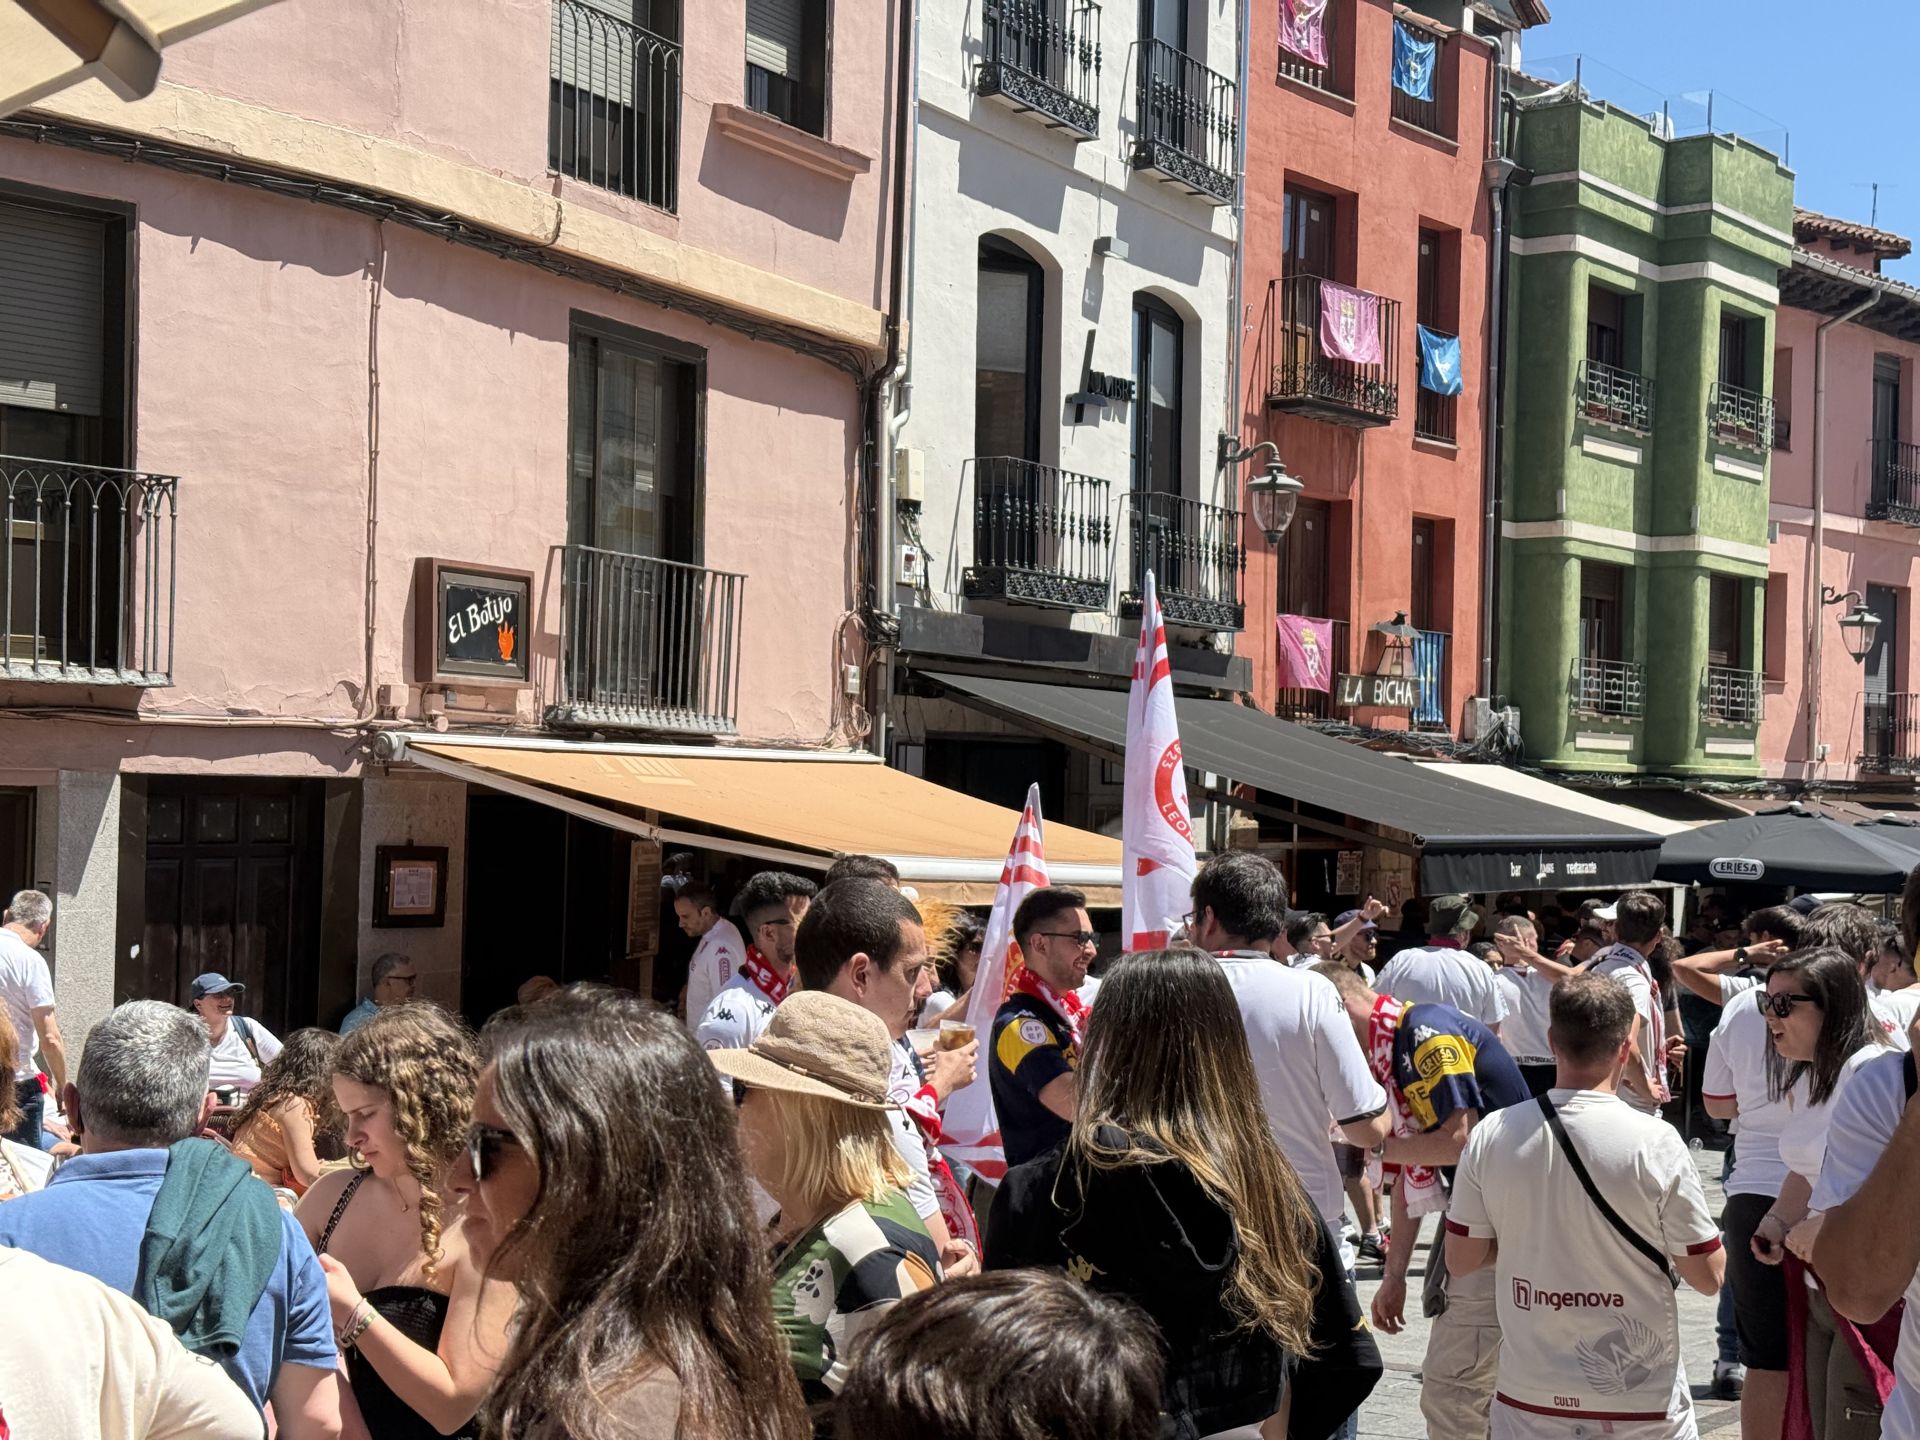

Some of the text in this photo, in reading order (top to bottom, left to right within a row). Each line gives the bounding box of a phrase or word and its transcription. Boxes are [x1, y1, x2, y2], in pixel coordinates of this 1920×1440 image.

[448, 596, 512, 644] El Botijo
[1344, 677, 1414, 705] LA BICHA
[1510, 861, 1521, 877] bar
[1713, 861, 1758, 876] CERLESA
[1534, 1289, 1625, 1311] ingenova
[1553, 1395, 1580, 1408] CULTU
